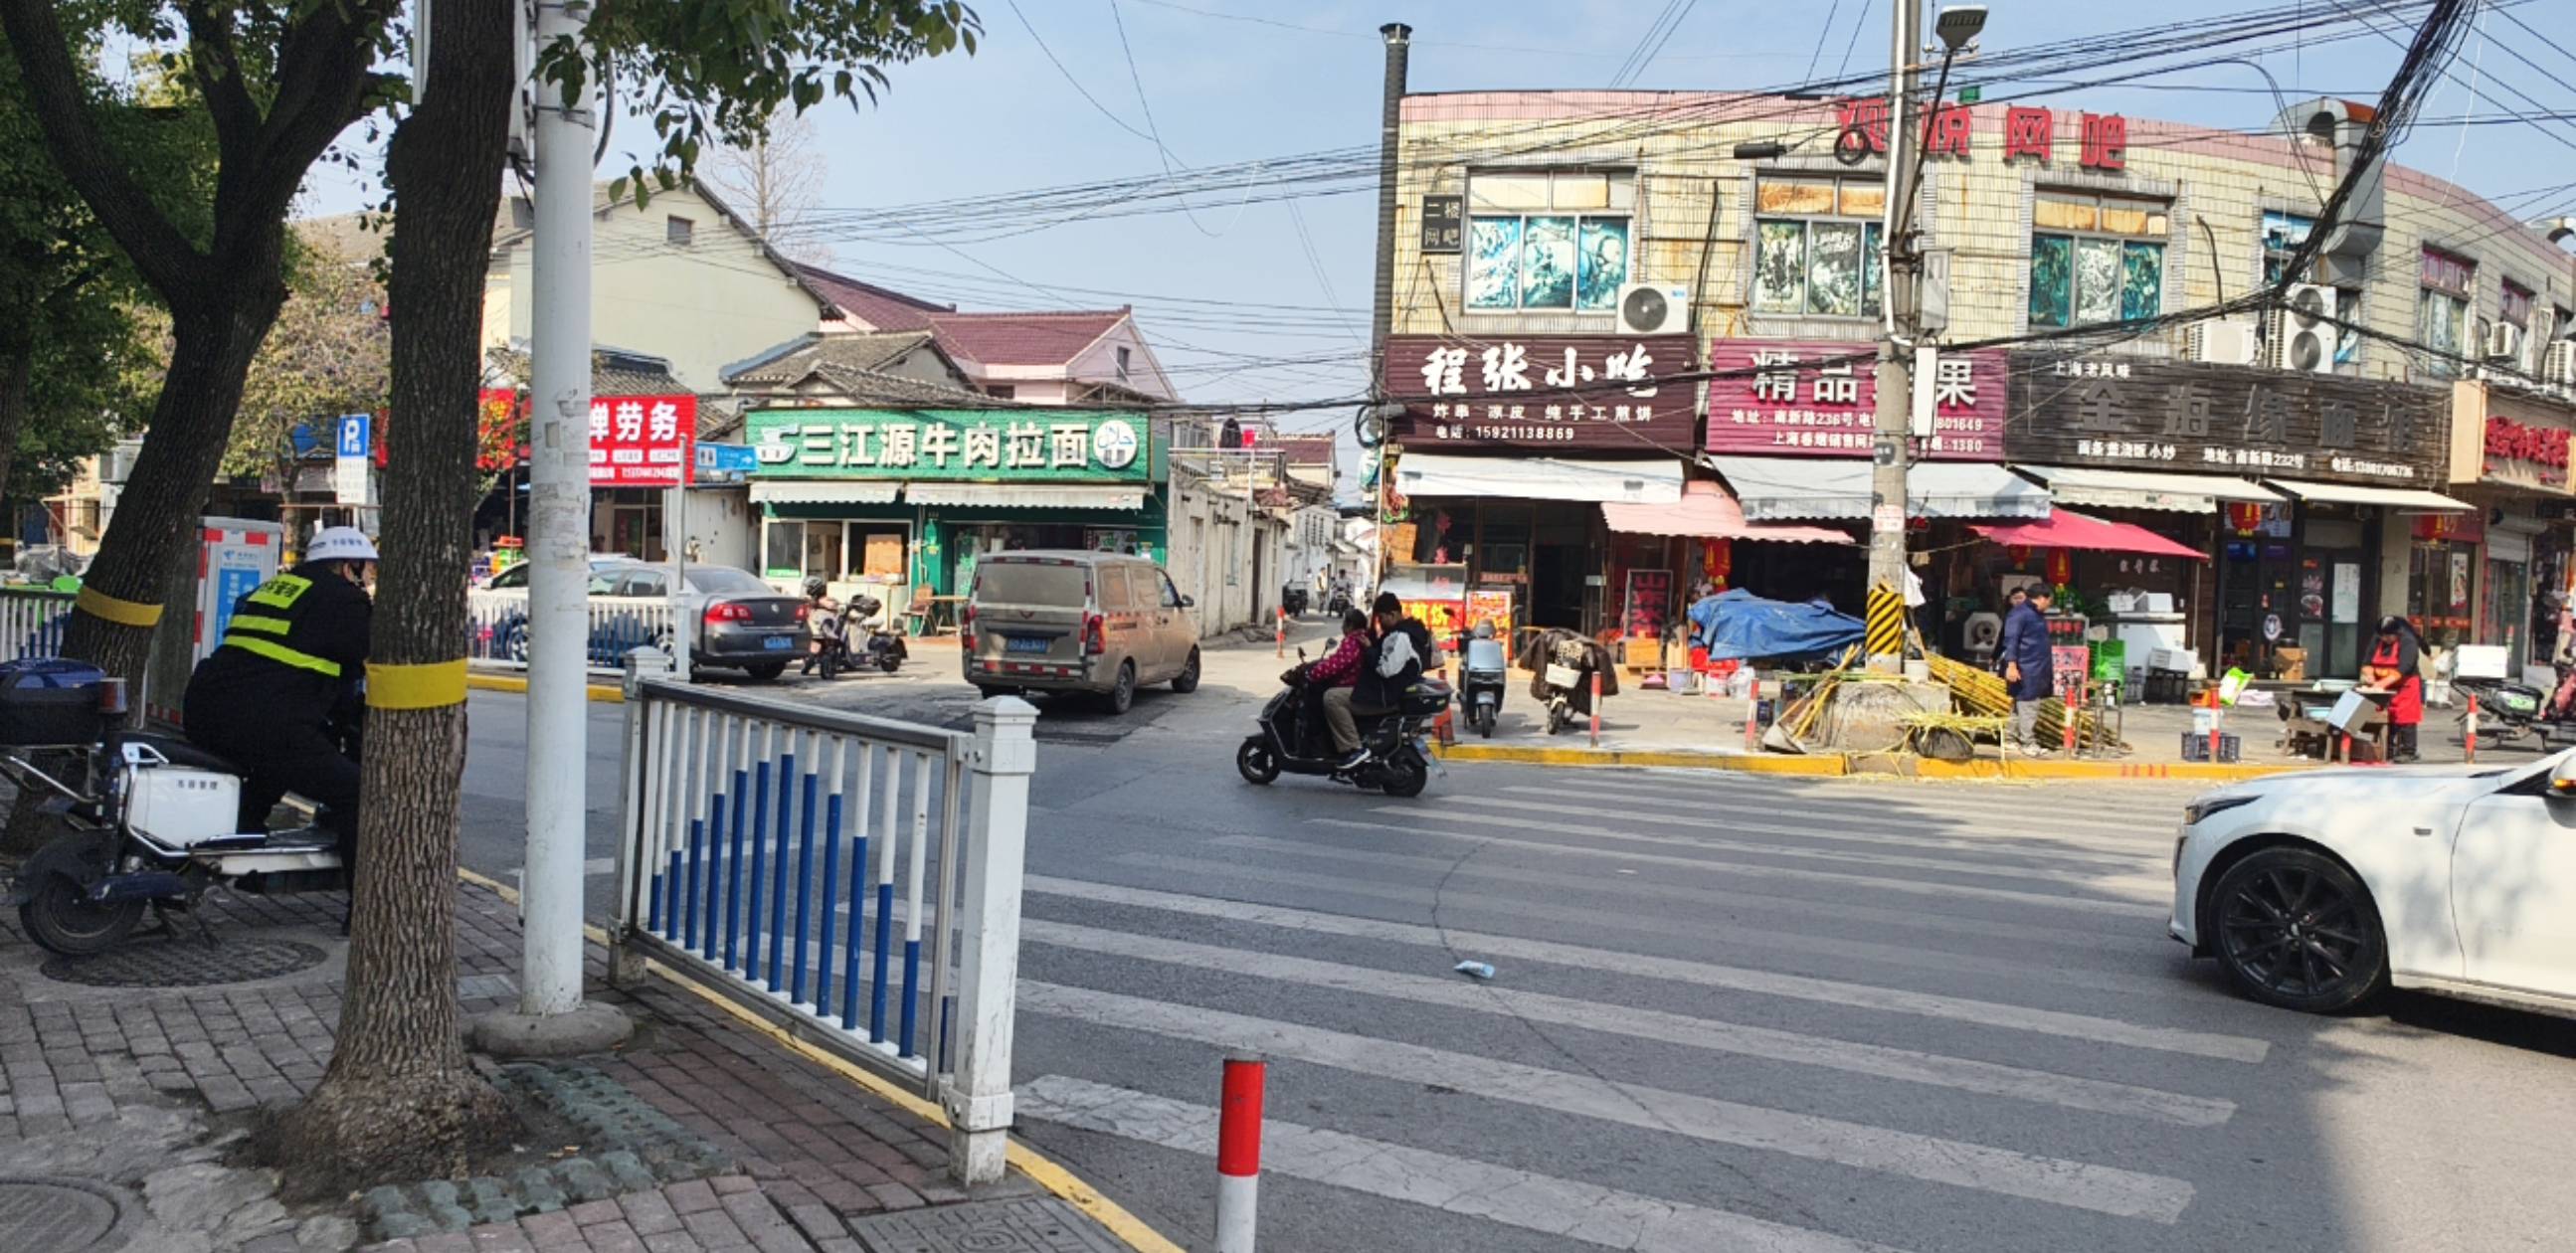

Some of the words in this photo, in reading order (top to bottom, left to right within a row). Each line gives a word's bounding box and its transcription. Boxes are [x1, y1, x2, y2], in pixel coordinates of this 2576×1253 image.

[1426, 201, 1460, 219] 二楼
[1425, 228, 1460, 246] 网吧
[1421, 343, 1658, 397] 程张小吃
[1751, 349, 1977, 406] 精品果
[2053, 361, 2130, 379] 上海老风味
[343, 419, 361, 452] P
[800, 422, 1089, 467] 三江源牛肉拉面
